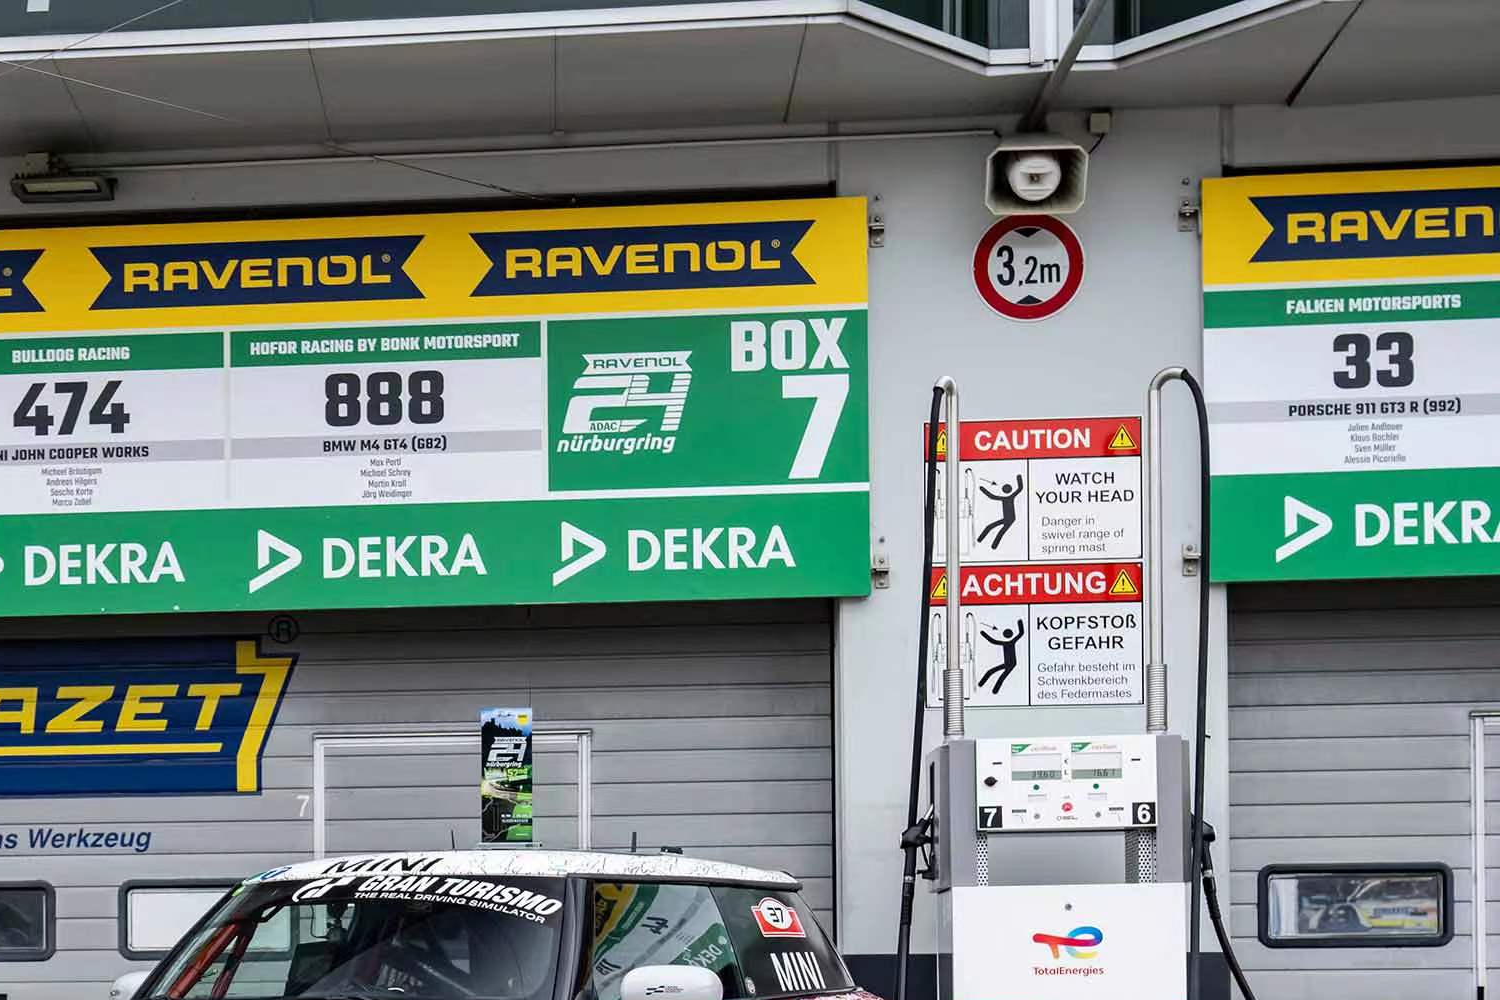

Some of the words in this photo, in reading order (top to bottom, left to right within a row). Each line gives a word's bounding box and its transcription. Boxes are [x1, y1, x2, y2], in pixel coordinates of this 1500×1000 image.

[506, 239, 781, 279] RAVENOL
[997, 245, 1061, 287] 3,2m
[123, 254, 391, 293] RAVENOL
[1286, 298, 1344, 314] FALKEN
[1348, 294, 1461, 312] MOTORSPORTS
[250, 341, 298, 357] HOFOR
[301, 340, 354, 355] RACING
[358, 339, 377, 354] BY
[380, 337, 420, 352] BONK
[424, 333, 520, 351] MOTORSPORT
[731, 317, 850, 372] BOX
[12, 348, 74, 364] BULLDOG
[78, 346, 130, 362] RACING
[593, 356, 682, 370] RAVENOL
[1333, 332, 1415, 389] 33
[13, 380, 130, 436] 474
[325, 370, 445, 428] 888
[1289, 403, 1352, 417] PORSCHE
[1355, 402, 1377, 416] 911
[1380, 401, 1406, 415] GT3
[1410, 401, 1419, 414] R
[1423, 398, 1462, 415] (992)
[589, 422, 618, 432] ADAC
[782, 373, 850, 479] 7
[323, 440, 357, 453] BMW
[360, 439, 380, 452] M4
[384, 438, 408, 452] GT4
[411, 436, 447, 452] (G82)
[557, 433, 676, 456] nürburgring
[974, 428, 1091, 451] CAUTION
[12, 449, 45, 462] JOHN
[49, 447, 98, 460] COOPER
[102, 445, 150, 459] WORKS
[1055, 471, 1115, 486] WATCH
[1036, 490, 1083, 504] YOUR
[1088, 489, 1135, 503] HEAD
[1041, 516, 1082, 529] Danger
[1086, 516, 1095, 527] in
[1355, 500, 1500, 547] DEKR
[1041, 529, 1075, 540] swivel
[1078, 530, 1110, 542] range
[1113, 528, 1125, 539] of
[323, 533, 488, 580] DEKRA
[628, 524, 797, 572] DEKRA
[1041, 542, 1075, 554] spring
[1078, 542, 1106, 552] mast
[24, 541, 186, 587] DEKRA
[962, 571, 1107, 597] ACHTUNG
[1036, 613, 1137, 631] KOPFSTOß
[1048, 635, 1124, 650] GEFAHR
[1037, 662, 1076, 673] Gefahr
[1078, 661, 1119, 672] besteht
[1122, 662, 1136, 672] im
[1037, 674, 1129, 687] Schwenkbereich
[1037, 689, 1058, 700] des
[1061, 687, 1132, 700] Federmastes
[296, 794, 311, 818] 7
[1137, 804, 1151, 823] 6
[983, 807, 998, 827] 7
[28, 827, 152, 853] Werkzeug
[322, 857, 443, 876] MINI
[358, 875, 443, 895] GRAN
[444, 877, 565, 916] TURISMO
[353, 892, 375, 900] THE
[380, 892, 411, 900] REAL
[414, 893, 467, 906] DRIVING
[468, 898, 546, 925] SIMULATOR
[767, 906, 784, 925] 37
[770, 951, 827, 991] MINI
[1033, 966, 1105, 977] TotalEnergies
